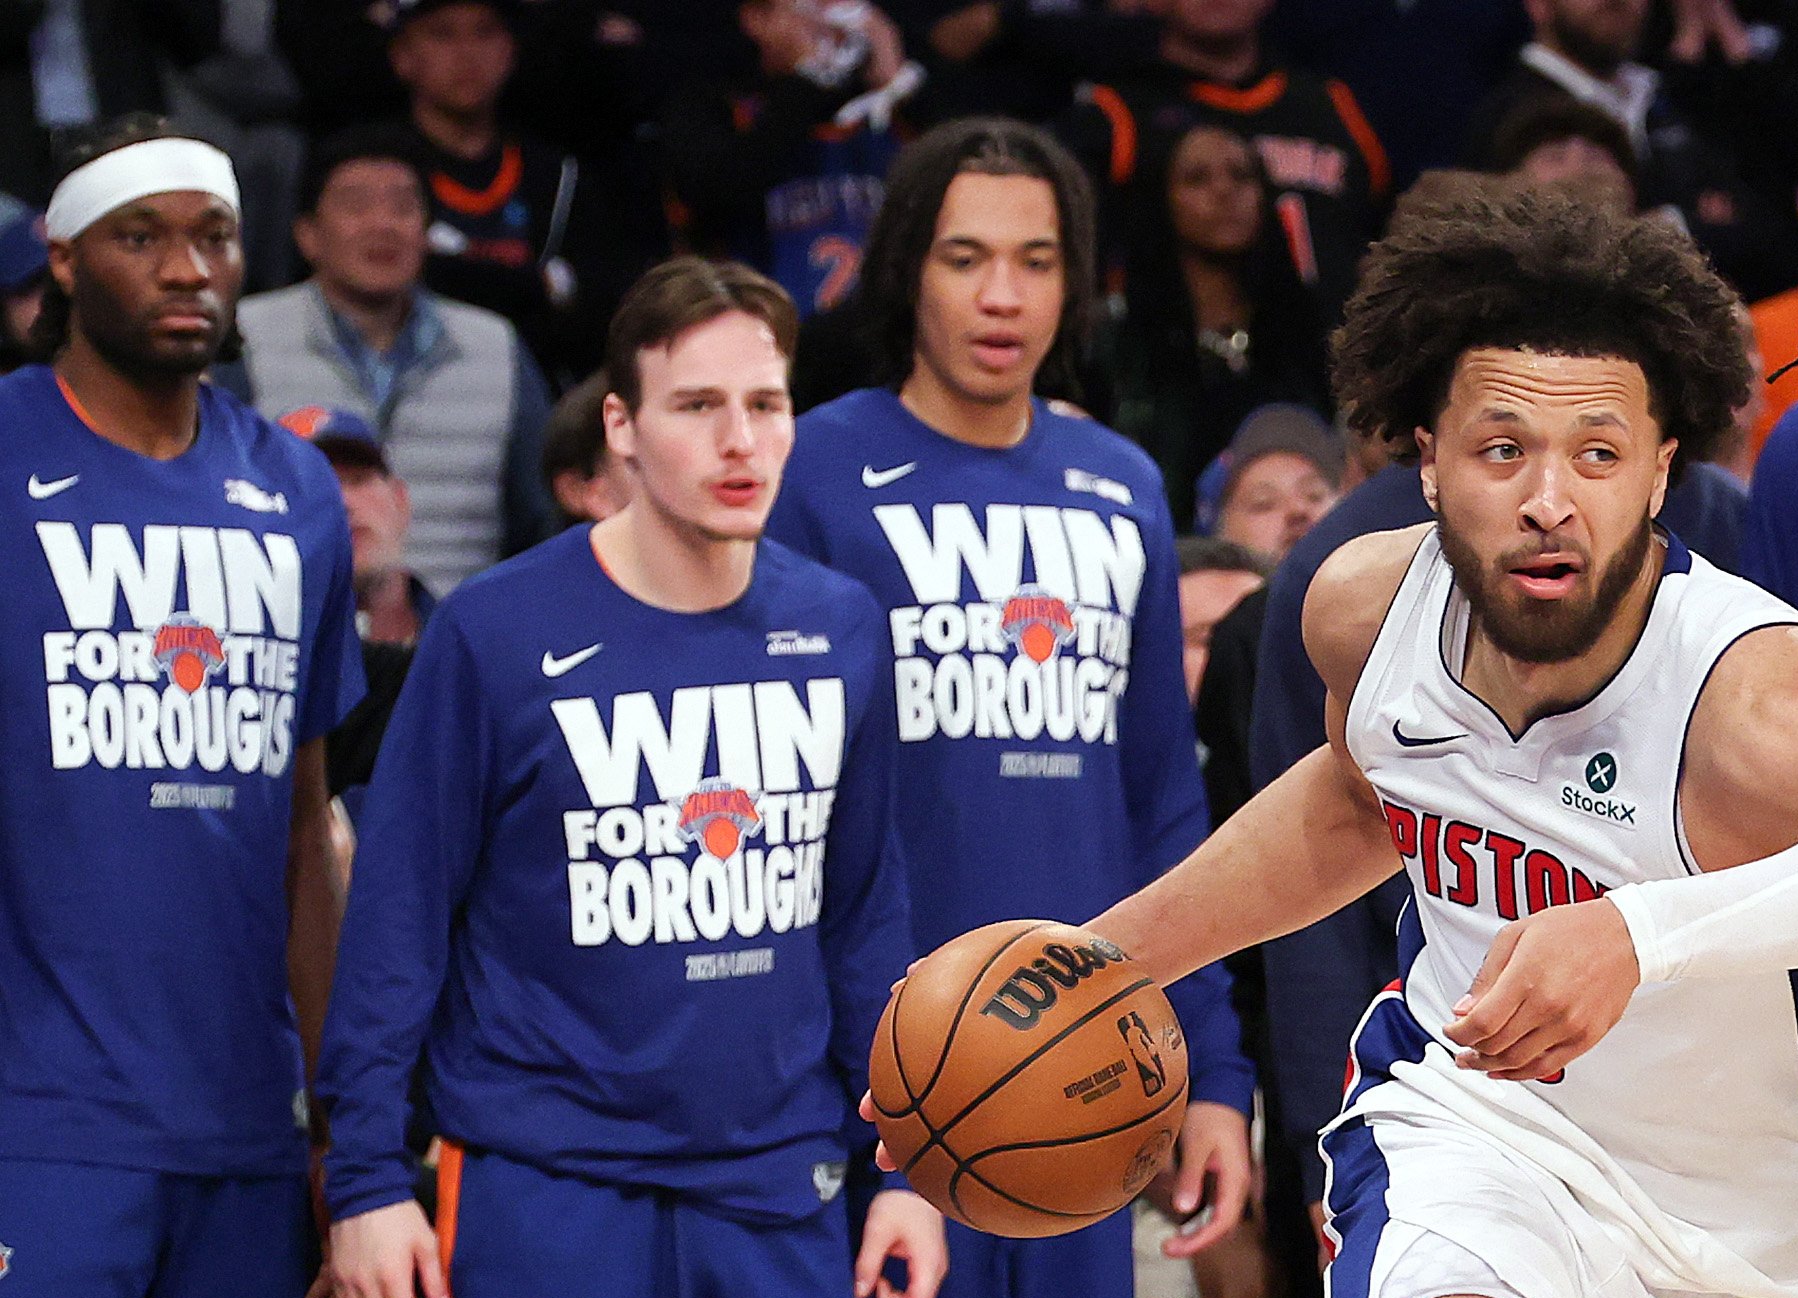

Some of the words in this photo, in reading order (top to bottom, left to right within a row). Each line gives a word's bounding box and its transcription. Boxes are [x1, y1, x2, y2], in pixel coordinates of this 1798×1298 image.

[35, 520, 302, 639] WIN
[871, 502, 1147, 617] WIN
[43, 630, 160, 683] FOR
[223, 633, 300, 692] THE
[890, 603, 1008, 658] FOR
[550, 677, 846, 808] WIN
[893, 652, 1130, 746] BOROUG
[563, 803, 688, 860] FOR
[1561, 786, 1636, 825] StockX
[1383, 800, 1620, 921] PISTO
